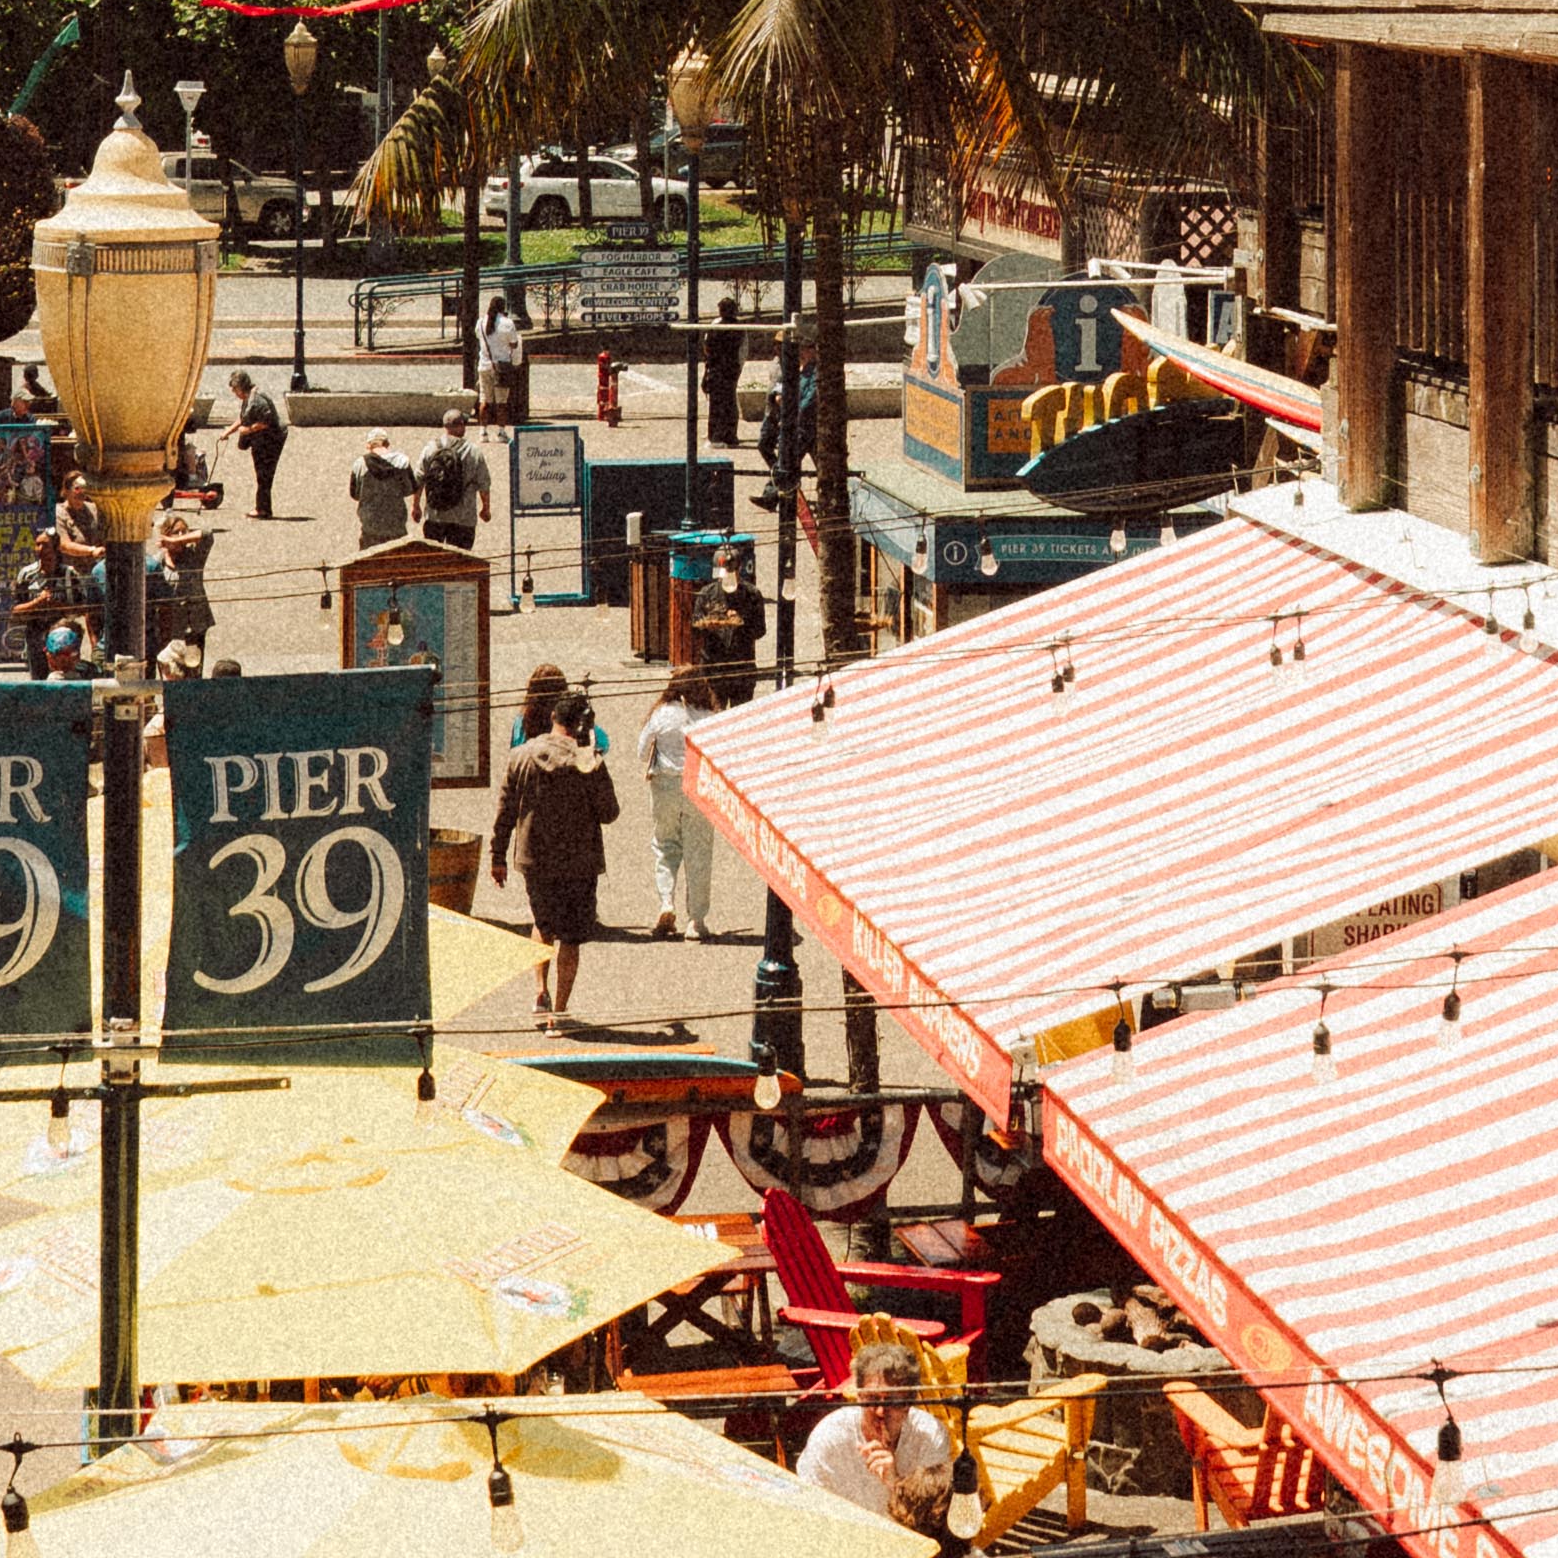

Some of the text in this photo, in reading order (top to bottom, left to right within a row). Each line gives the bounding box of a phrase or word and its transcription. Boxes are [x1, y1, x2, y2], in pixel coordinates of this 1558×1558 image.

[611, 226, 637, 237] PIER
[601, 253, 661, 261] FOG HARBOR
[602, 268, 657, 276] EAGLE CAFE
[600, 282, 659, 291] CRAB HOUSE
[593, 298, 669, 306] WELCOME CENTER
[595, 313, 623, 321] LEVEL
[633, 313, 665, 321] SHOPS
[526, 446, 564, 458] Thanks
[525, 469, 567, 484] Visiting
[1000, 543, 1028, 556] PIER
[1031, 543, 1045, 555] 39
[1050, 544, 1097, 556] TICKETS
[204, 745, 396, 823] PIER
[192, 825, 406, 995] 39
[852, 906, 905, 995] KILLER
[1148, 1202, 1228, 1328] PIZZAS
